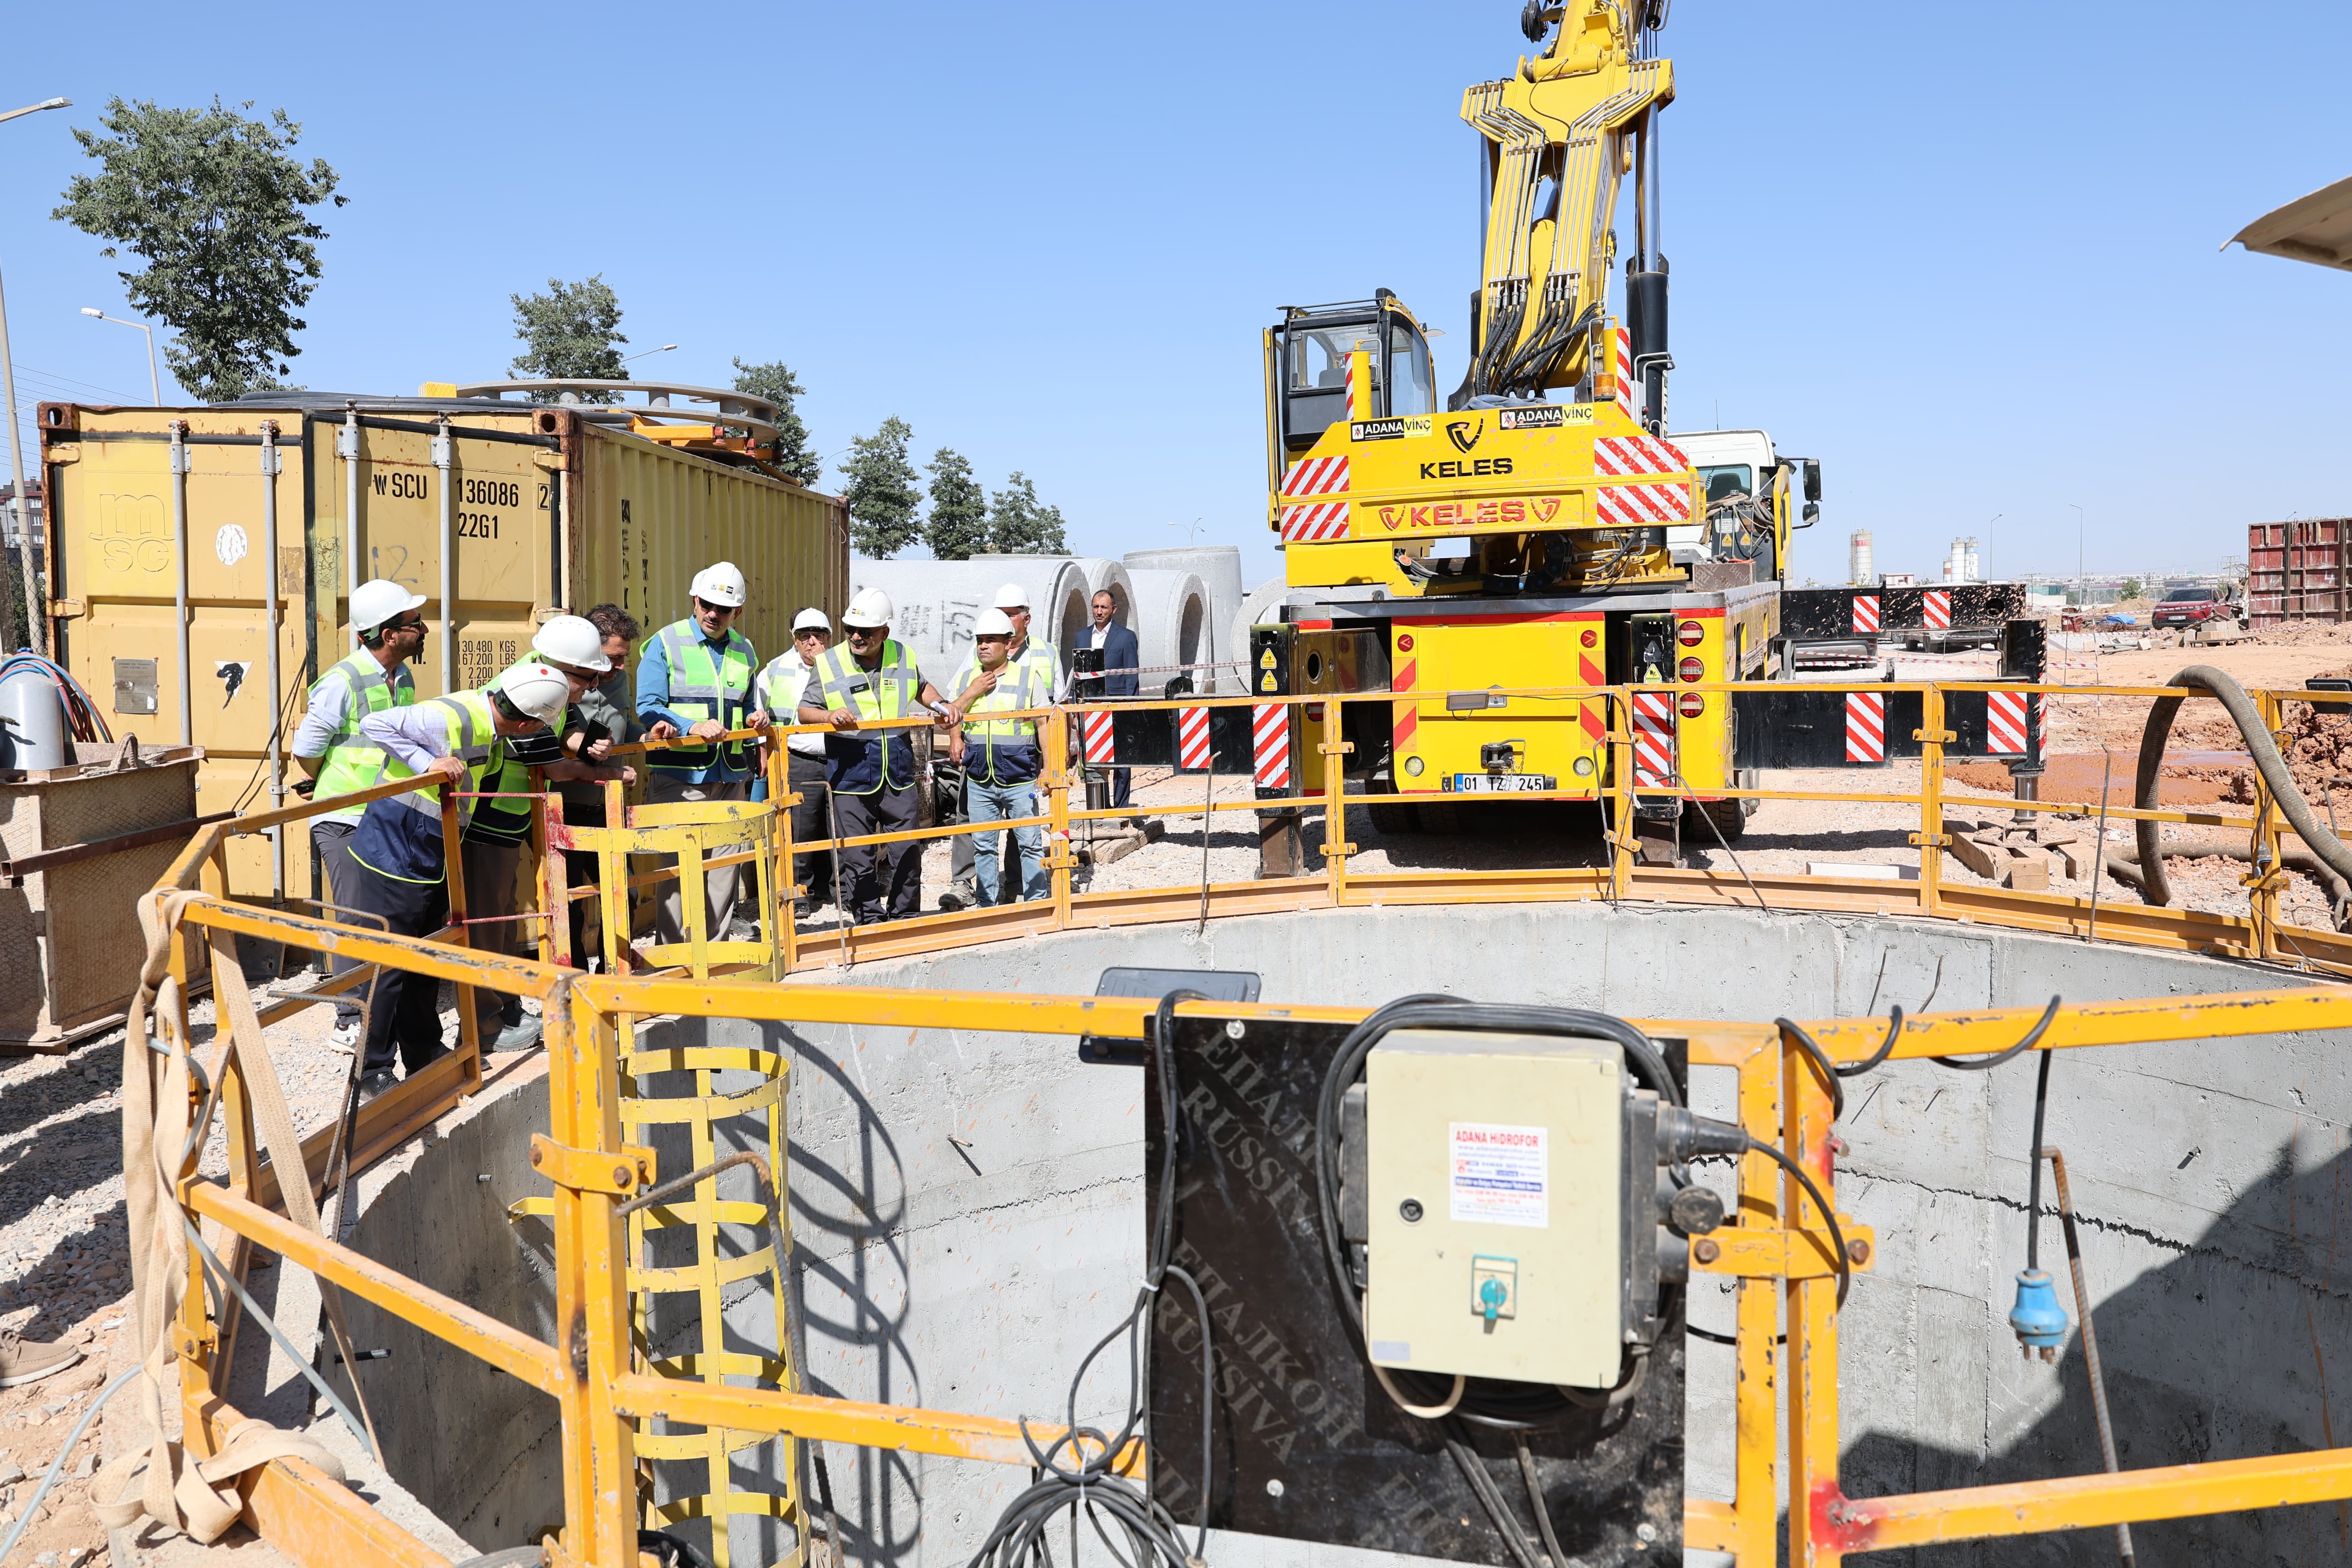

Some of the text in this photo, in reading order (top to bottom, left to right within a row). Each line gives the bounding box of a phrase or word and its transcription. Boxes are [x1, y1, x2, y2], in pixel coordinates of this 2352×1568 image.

[1517, 407, 1592, 422] ADANA VİNÇ
[1365, 419, 1431, 434] ADANA VİNÇ
[1420, 458, 1513, 479] KELES
[456, 477, 519, 508] 136086
[539, 485, 548, 509] 2
[1410, 500, 1526, 526] KELES
[458, 512, 498, 539] 22G1
[1729, 565, 1749, 583] Birch
[499, 640, 516, 653] KGS
[500, 653, 516, 665] LBS
[1464, 777, 1542, 791] 01 TZ 245
[1456, 1130, 1487, 1143] ADANA
